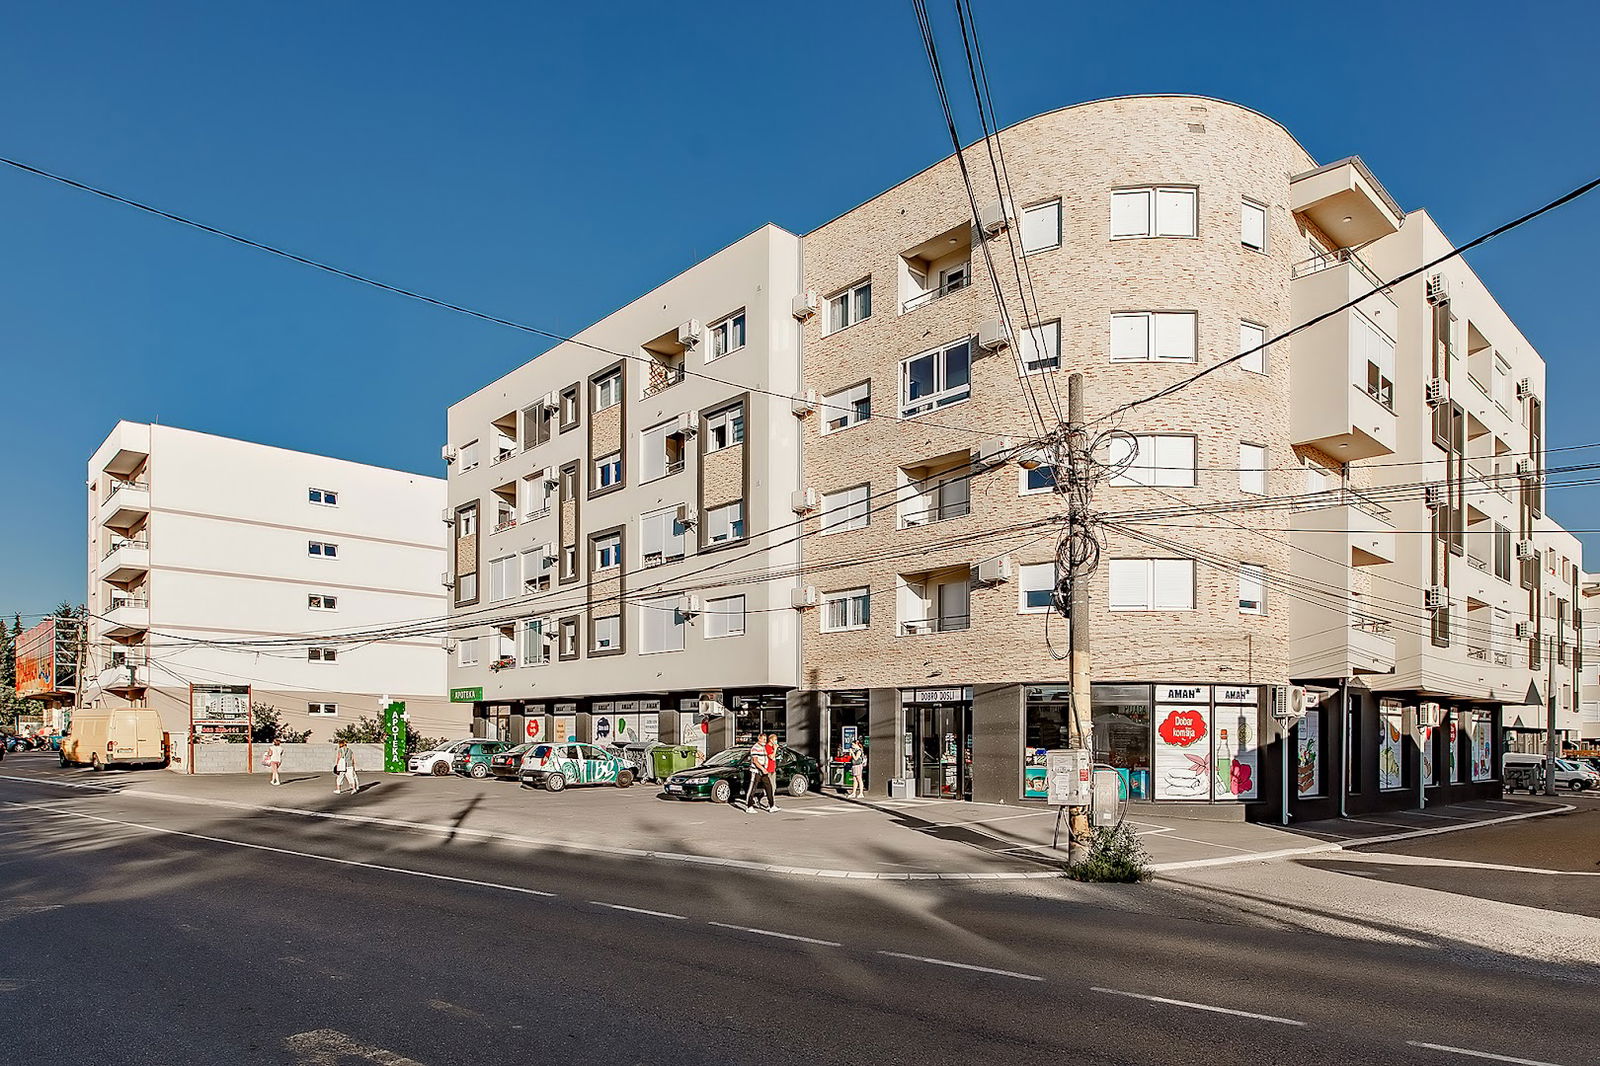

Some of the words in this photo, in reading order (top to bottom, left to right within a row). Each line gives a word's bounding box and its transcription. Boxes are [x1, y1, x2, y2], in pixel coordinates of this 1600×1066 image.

[454, 690, 475, 699] APOTEKA
[921, 691, 938, 701] DOBRO
[1174, 716, 1194, 726] Dobar
[391, 711, 400, 763] APOTEKA
